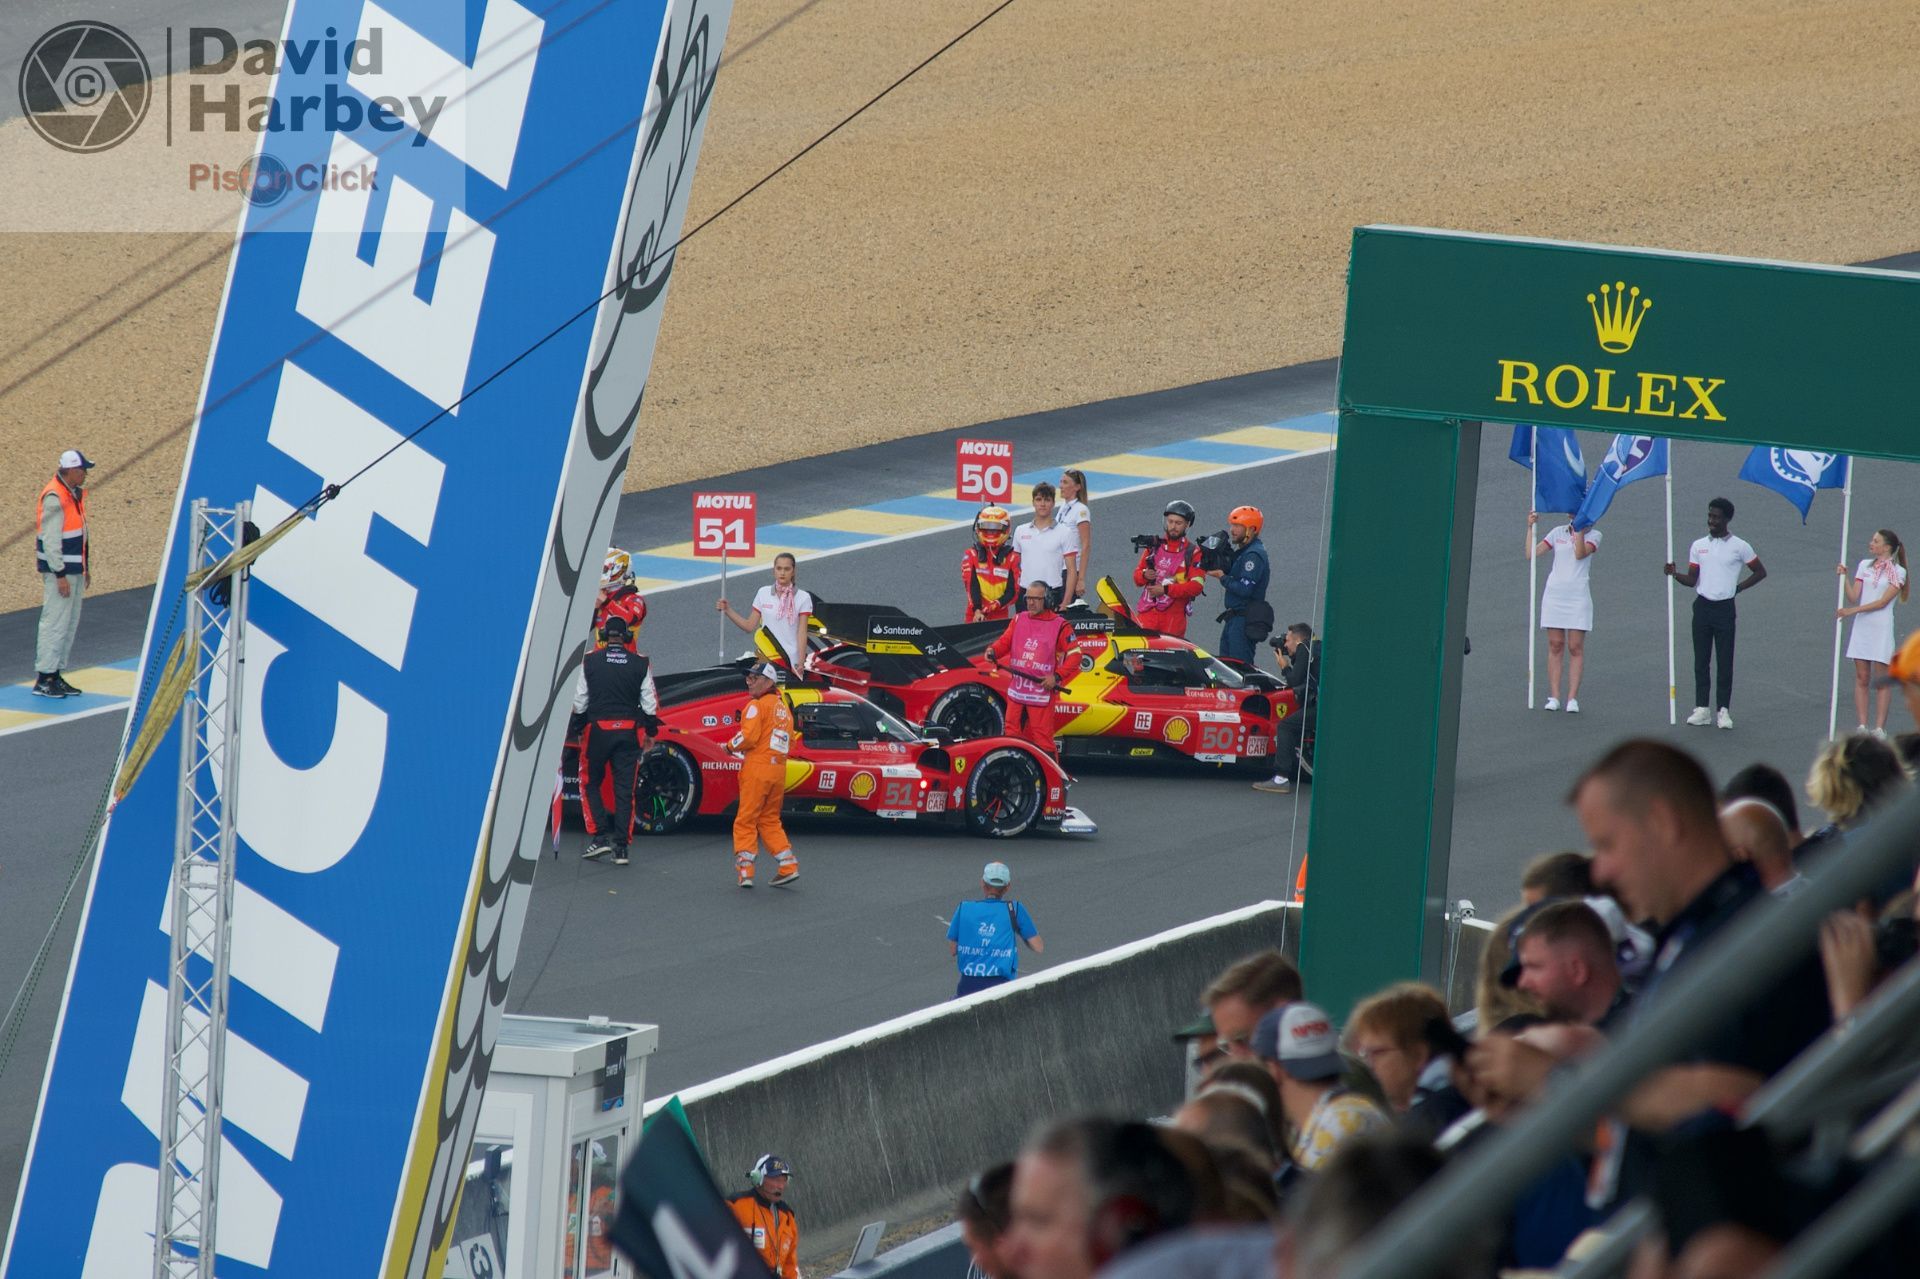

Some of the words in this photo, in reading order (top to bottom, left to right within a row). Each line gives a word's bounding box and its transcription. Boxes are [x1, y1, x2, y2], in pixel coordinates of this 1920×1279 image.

[1495, 359, 1727, 422] ROLEX
[960, 441, 1010, 457] MOTUL
[961, 464, 1008, 496] 50
[696, 495, 753, 509] MOTUL
[699, 518, 750, 551] 51
[883, 626, 923, 636] Santander
[1075, 622, 1098, 630] ADLER
[1055, 705, 1083, 714] MILLE
[1202, 726, 1233, 750] 50
[702, 762, 741, 770] RICHARD
[885, 782, 912, 806] 51
[928, 800, 945, 811] CAR
